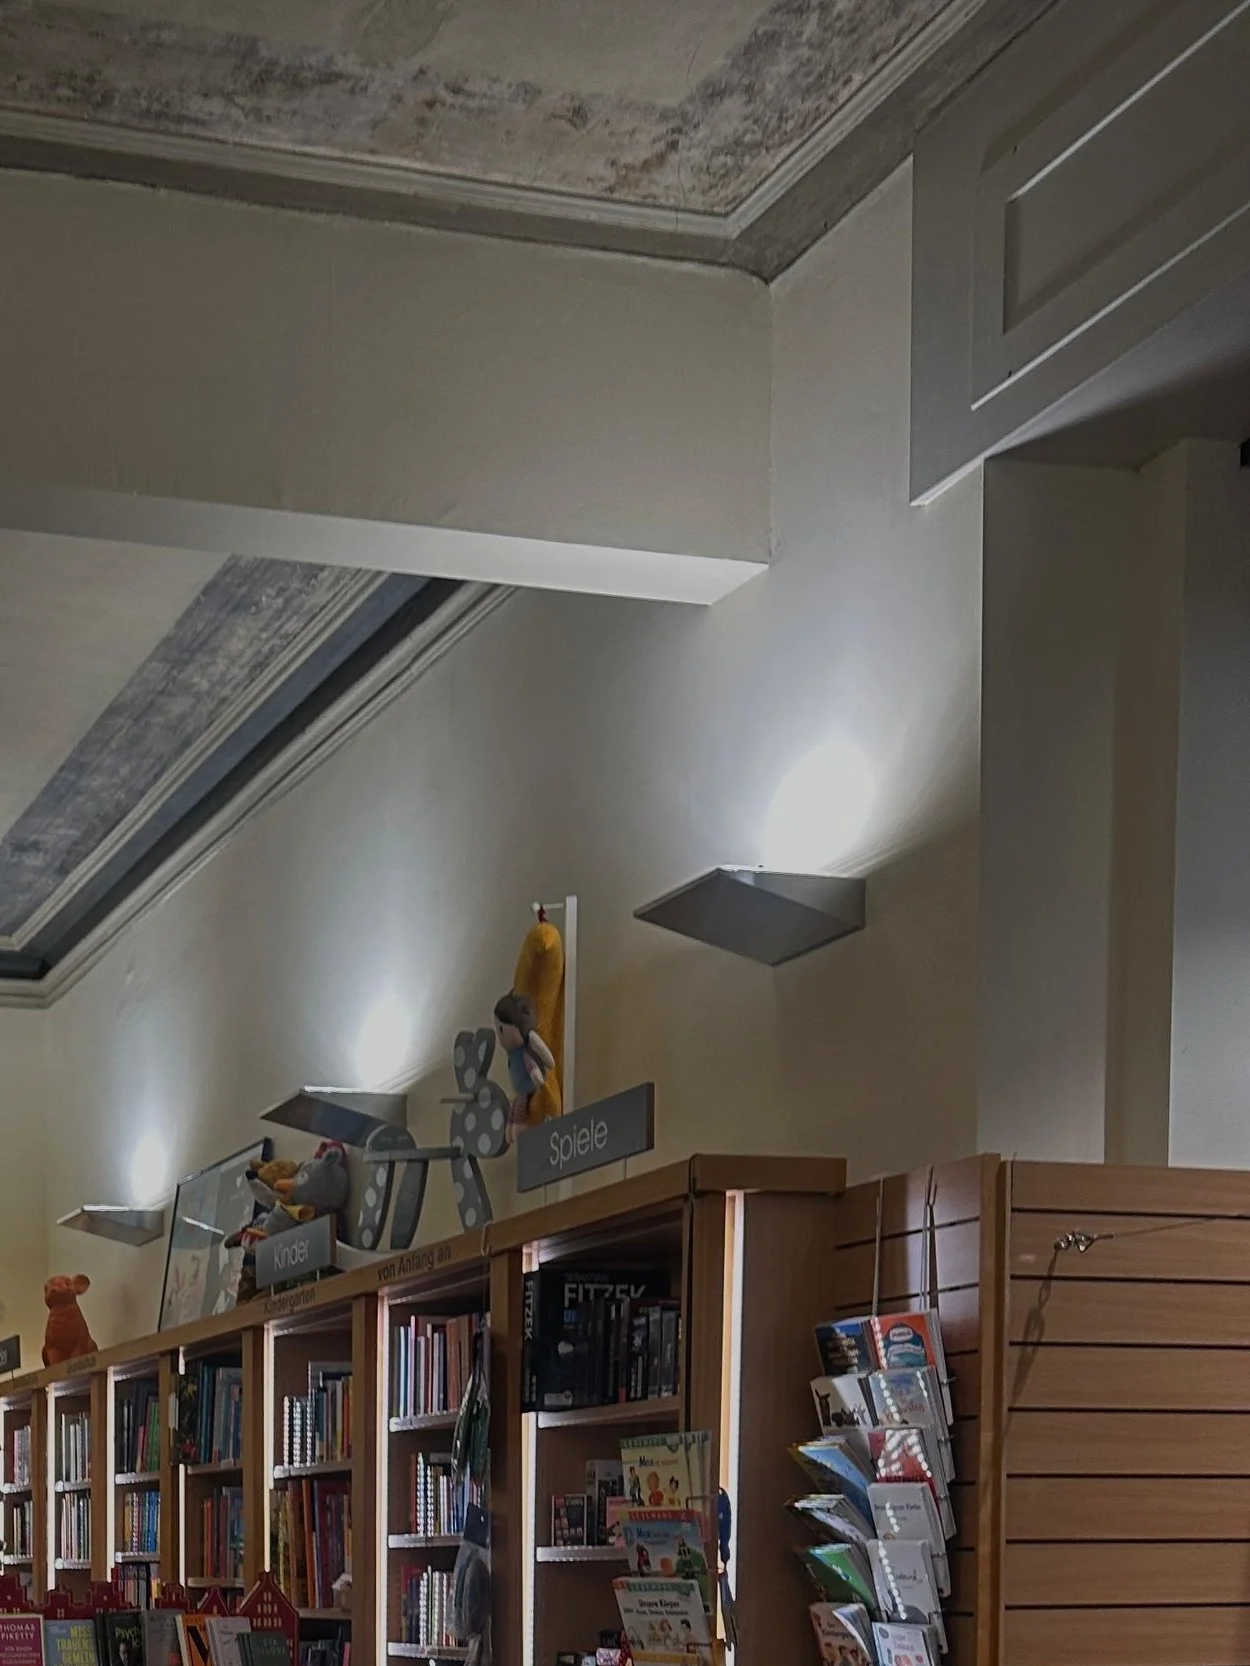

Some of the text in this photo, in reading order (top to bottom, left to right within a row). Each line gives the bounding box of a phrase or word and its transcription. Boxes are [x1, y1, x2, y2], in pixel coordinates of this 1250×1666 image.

[550, 1119, 608, 1169] Spiele
[273, 1238, 310, 1271] Kinder
[377, 1245, 452, 1281] von Anfang an
[524, 1280, 533, 1341] FITZEK
[0, 1632, 35, 1640] PIKETTY
